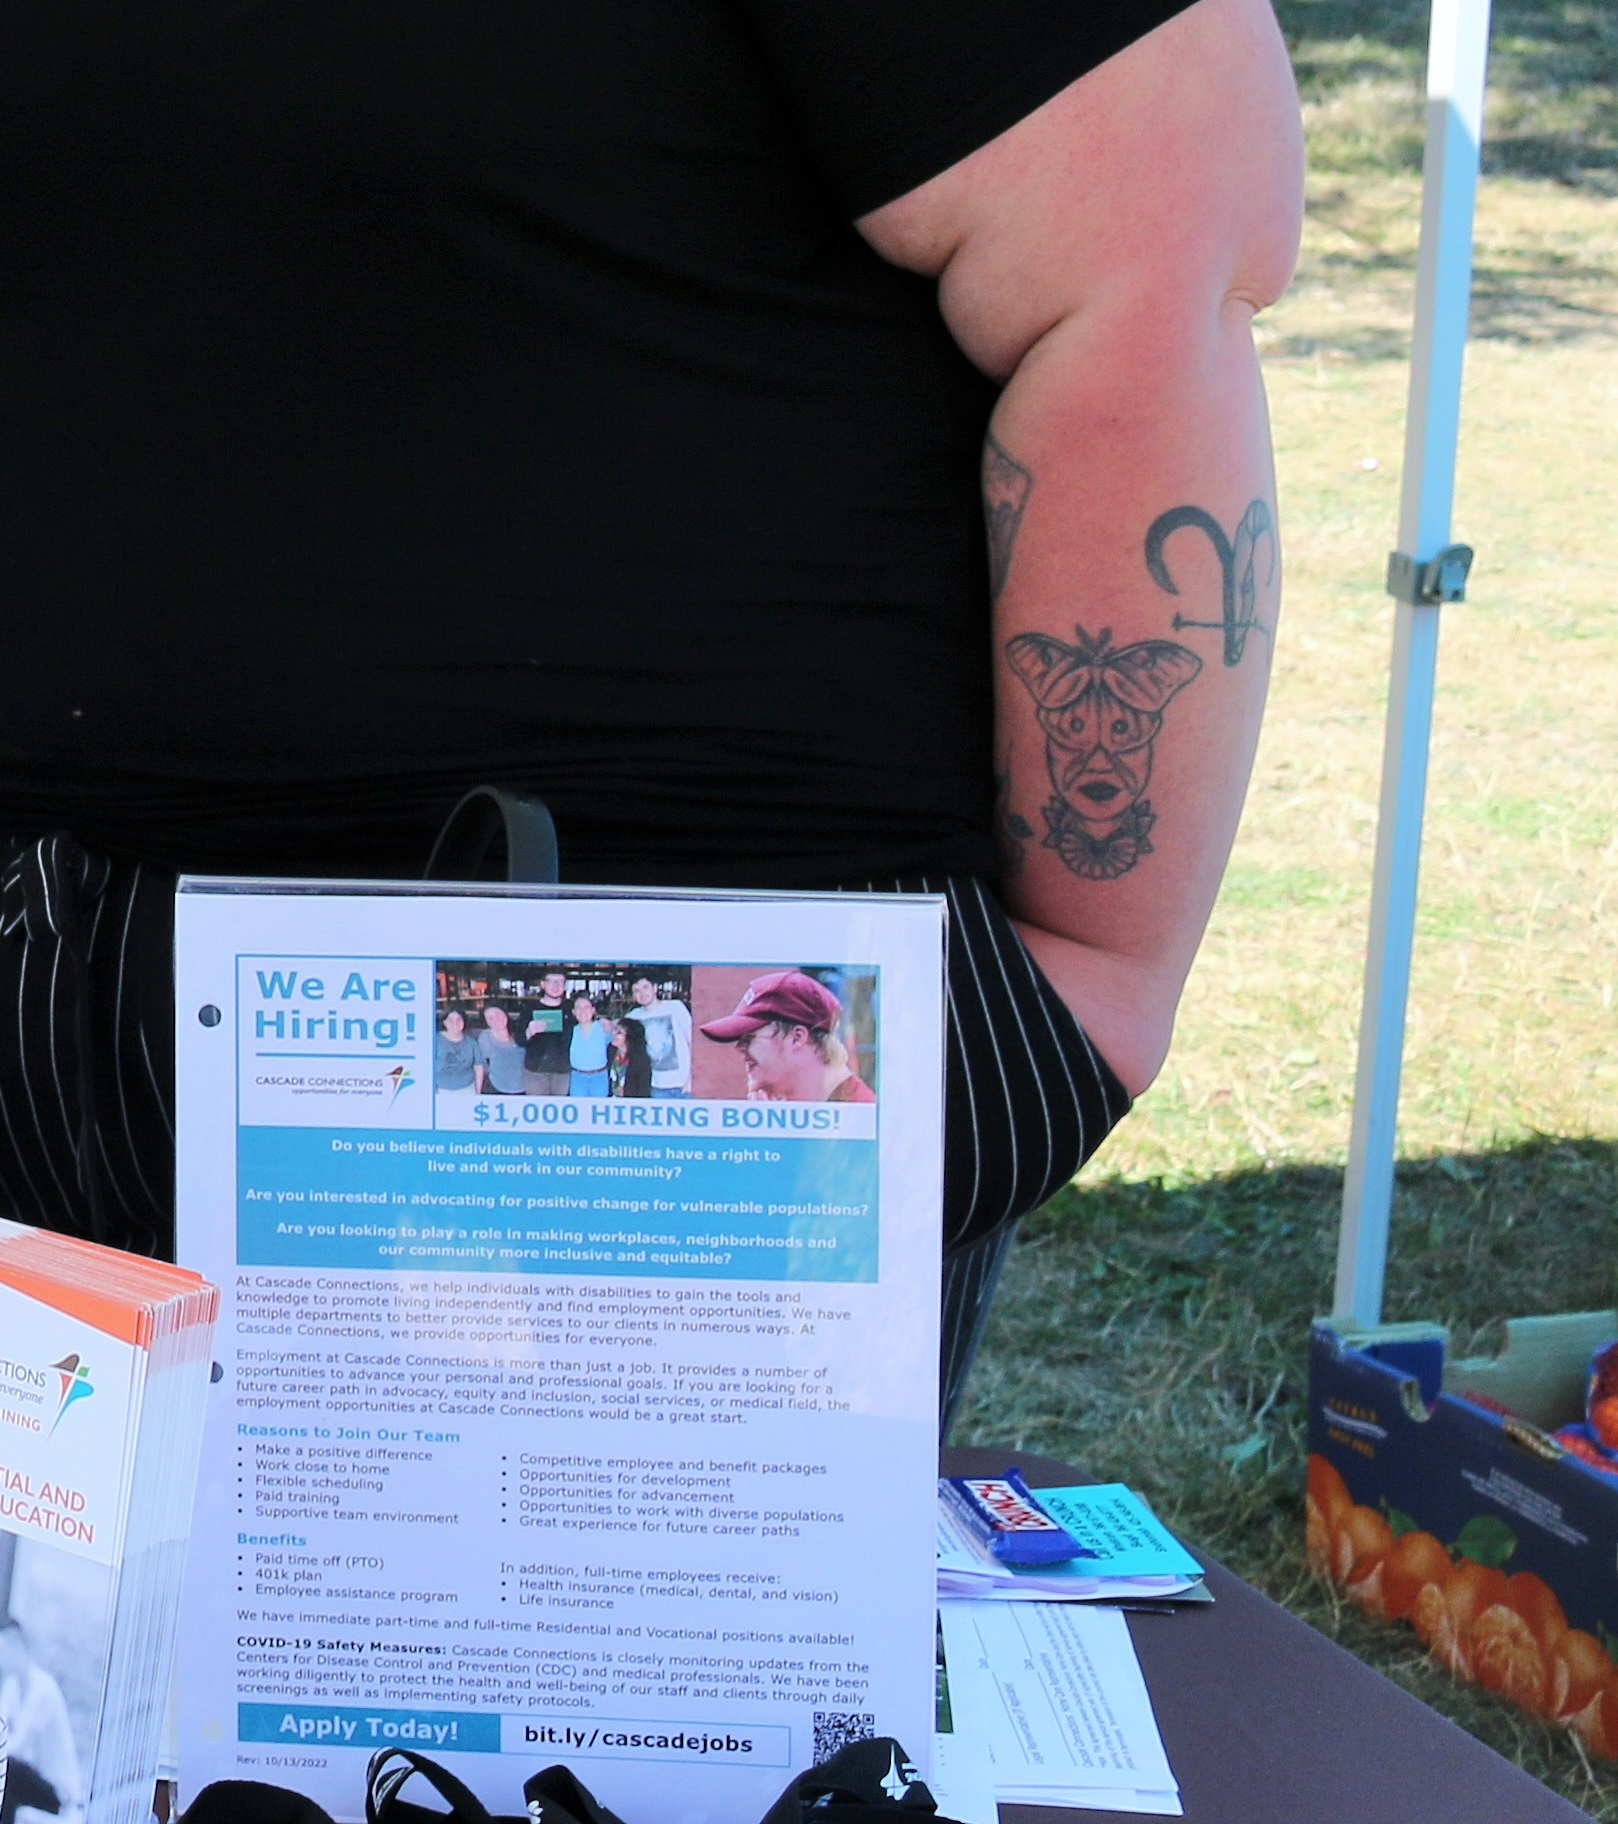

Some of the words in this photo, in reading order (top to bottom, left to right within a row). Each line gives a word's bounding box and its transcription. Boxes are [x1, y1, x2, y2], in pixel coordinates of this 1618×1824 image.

[255, 970, 324, 1000] We
[340, 972, 415, 1001] Are
[255, 1009, 415, 1048] Hiring!
[255, 1076, 303, 1085] CASCADE
[307, 1077, 382, 1086] CONNECTIONS
[473, 1100, 578, 1127] $1,000
[591, 1104, 708, 1127] HIRING
[722, 1107, 839, 1129] BONUS!
[331, 1139, 352, 1151] Do
[356, 1142, 384, 1153] you
[389, 1140, 444, 1153] believe
[449, 1142, 533, 1155] individuals
[537, 1143, 571, 1156] with
[577, 1144, 661, 1158] disabilities
[666, 1147, 703, 1160] have
[707, 1150, 716, 1160] a
[722, 1148, 759, 1163] right
[764, 1149, 780, 1161] to
[427, 1159, 455, 1172] live
[459, 1160, 487, 1173] and
[492, 1161, 531, 1173] work
[536, 1162, 550, 1174] in
[555, 1165, 582, 1175] our
[586, 1164, 681, 1180] community?
[237, 1423, 307, 1436] Reasons
[313, 1425, 330, 1437] to
[336, 1426, 370, 1439] Join
[377, 1428, 407, 1440] Our
[413, 1429, 459, 1442] Team
[255, 1443, 290, 1455] Make
[295, 1447, 303, 1455] a
[308, 1446, 360, 1458] positive
[365, 1447, 432, 1460] difference
[38, 1482, 84, 1511] AND
[237, 1532, 306, 1545] Benefits
[255, 1552, 282, 1564] Paid
[288, 1554, 317, 1565] time
[322, 1555, 340, 1566] off
[345, 1555, 384, 1570] (PTO)
[255, 1568, 288, 1579] 401k
[293, 1569, 322, 1582] plan
[236, 1636, 311, 1648] COVID-19
[317, 1639, 364, 1653] Safety
[370, 1641, 445, 1654] Measures:
[279, 1713, 357, 1740] Apply
[365, 1717, 457, 1744] Today!
[525, 1725, 752, 1754] bit.ly/cascadejobs
